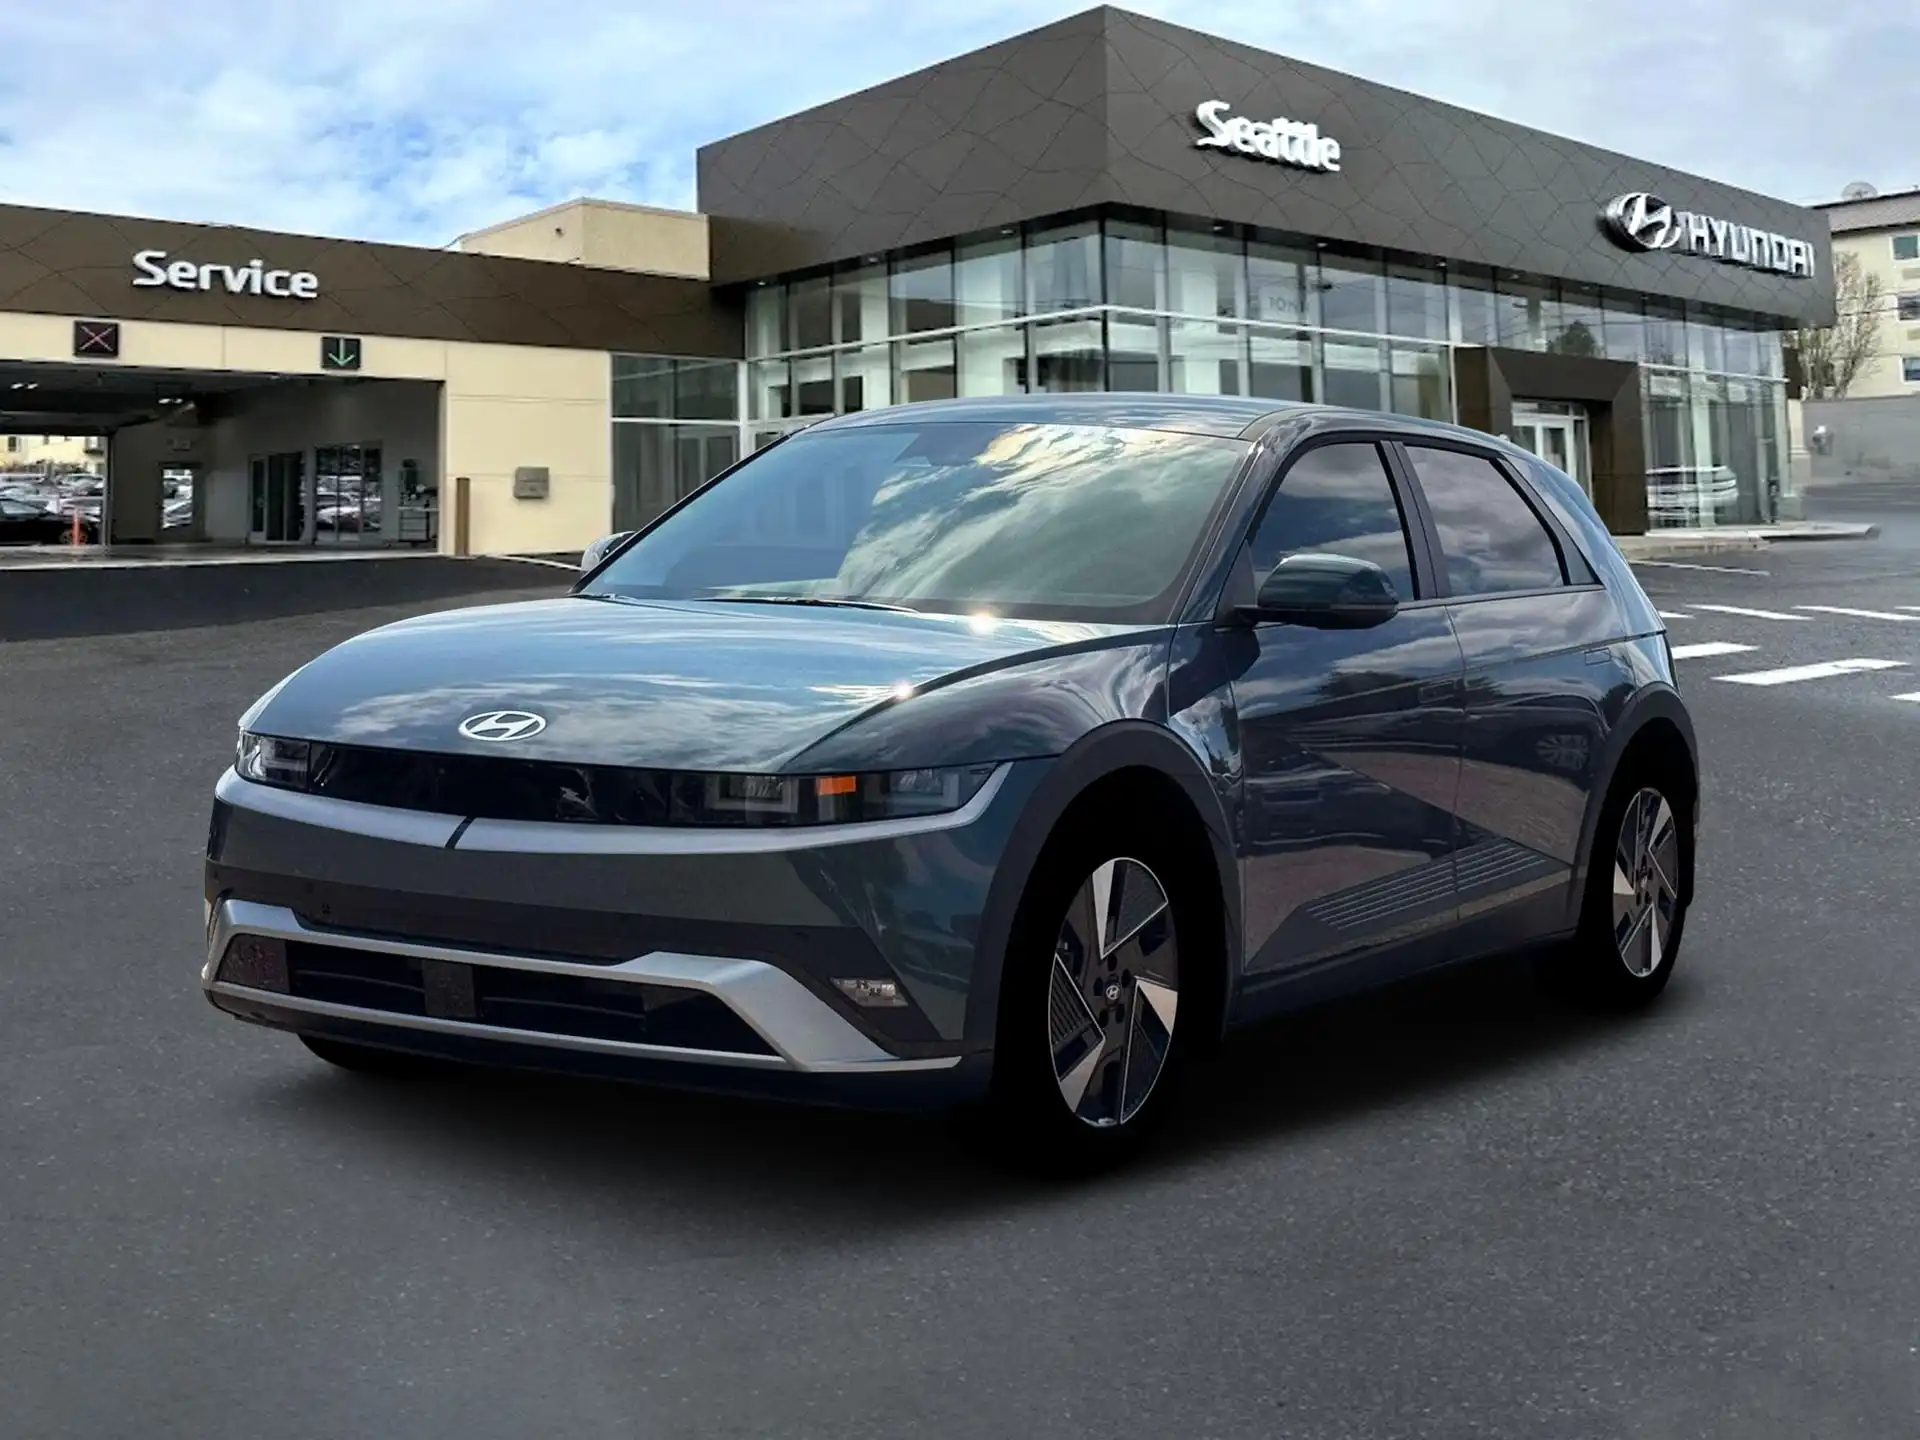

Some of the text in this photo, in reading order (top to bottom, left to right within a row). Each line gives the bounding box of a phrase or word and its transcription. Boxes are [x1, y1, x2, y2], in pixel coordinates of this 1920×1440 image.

[1196, 99, 1341, 171] Seattle
[132, 250, 319, 298] Service
[1681, 212, 1815, 278] HYUNDAI
